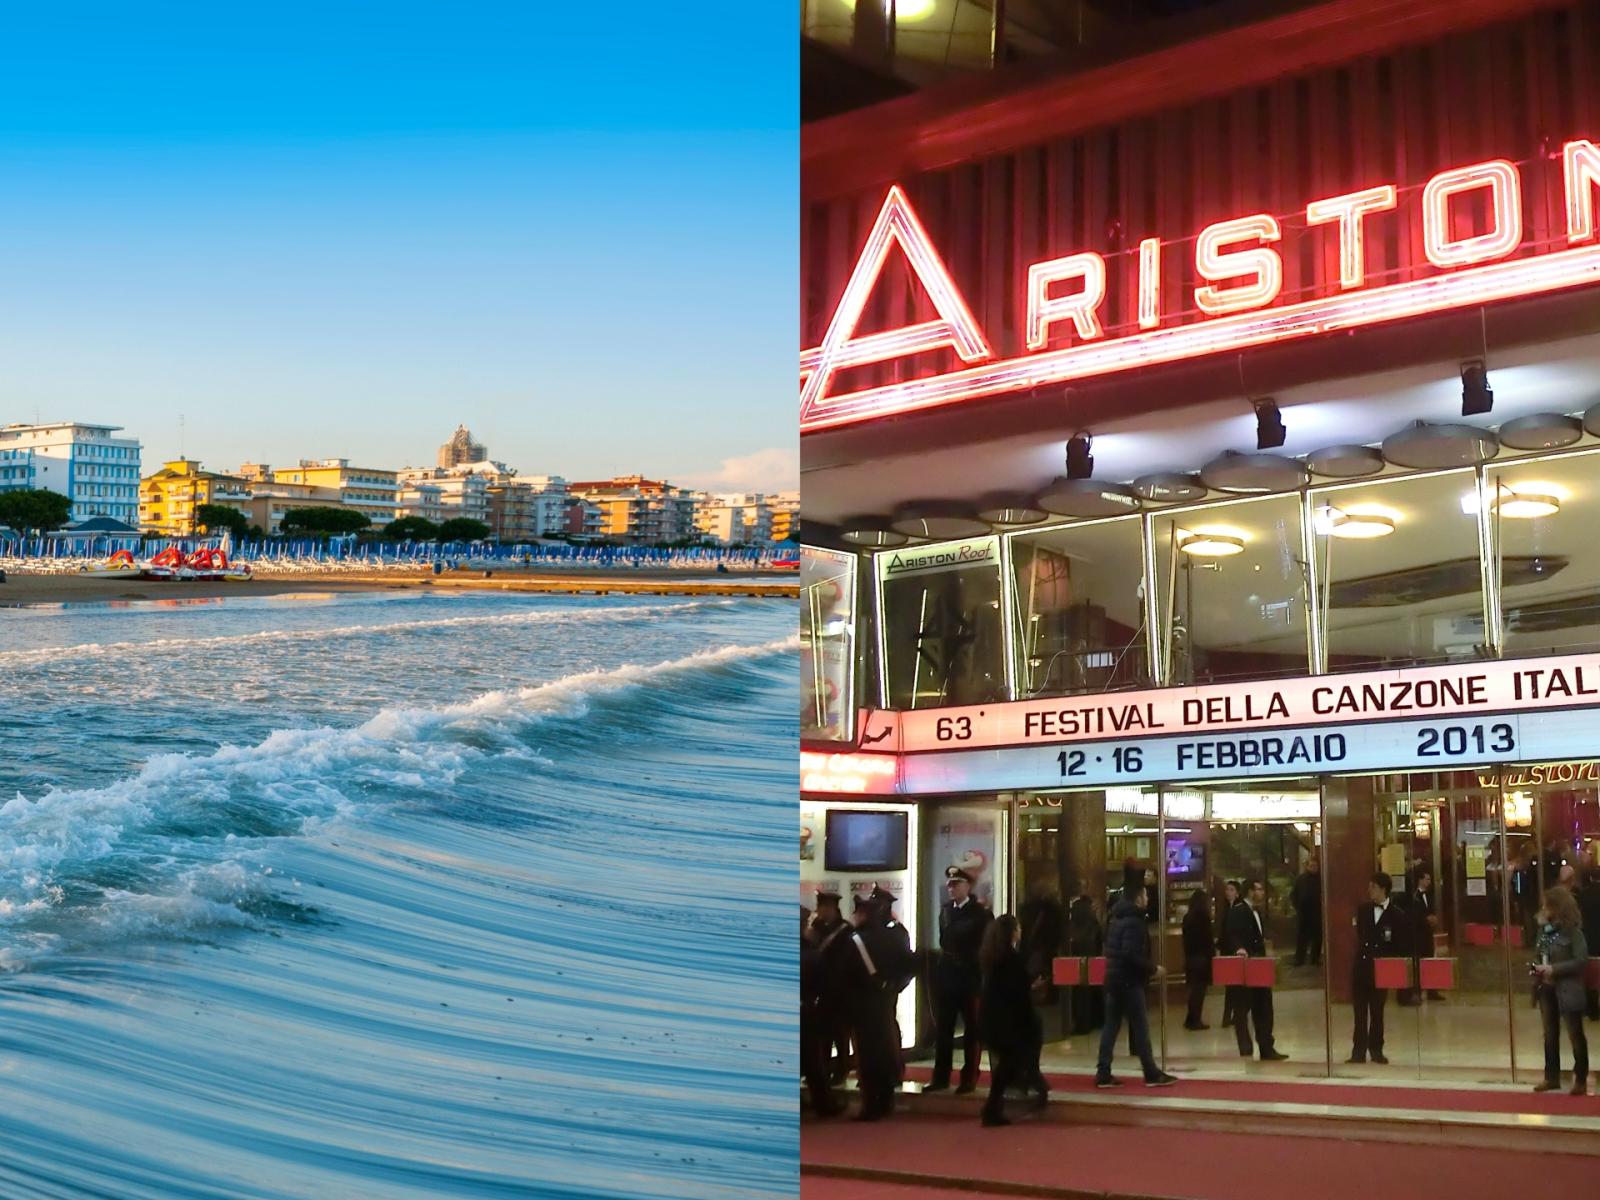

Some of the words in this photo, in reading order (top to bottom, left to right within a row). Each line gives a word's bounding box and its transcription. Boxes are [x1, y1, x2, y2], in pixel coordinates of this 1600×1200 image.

[886, 552, 956, 575] ARISTON
[959, 540, 994, 561] Roof
[1024, 705, 1165, 738] FESTIVAL
[1183, 692, 1290, 726] DELLA
[1312, 675, 1488, 715] CANZONE
[1176, 733, 1346, 771] FEBBRAIO
[1417, 723, 1515, 756] 2013
